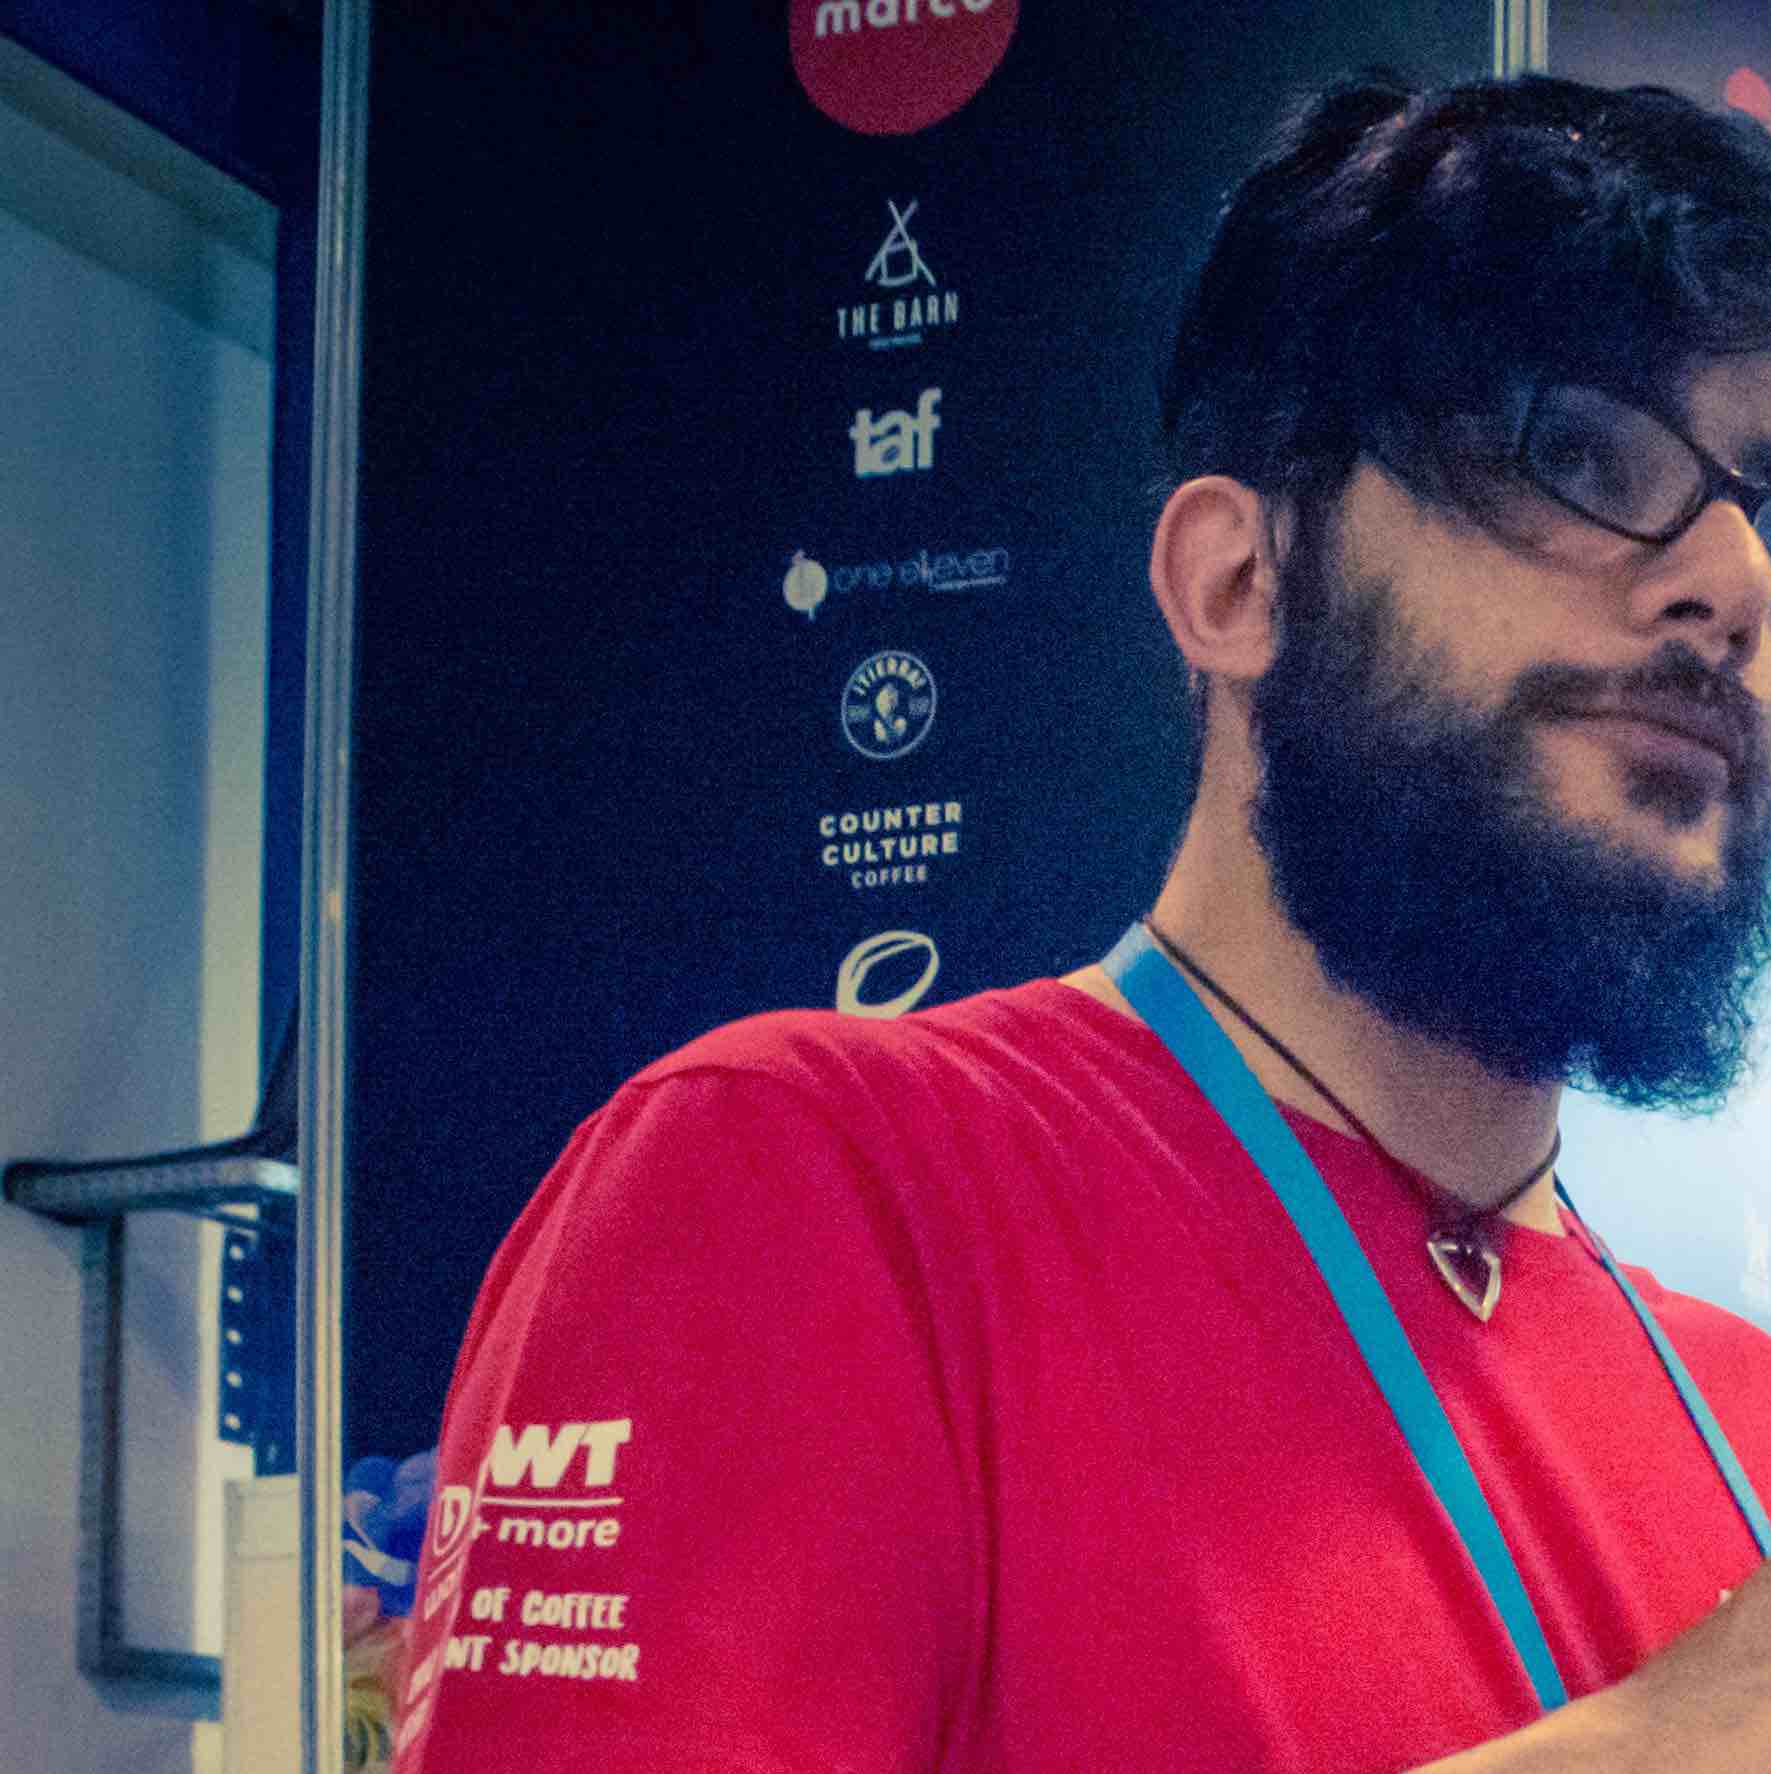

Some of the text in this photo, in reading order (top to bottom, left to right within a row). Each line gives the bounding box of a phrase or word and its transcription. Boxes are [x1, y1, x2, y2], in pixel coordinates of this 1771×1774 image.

[837, 292, 959, 339] THE BARN
[848, 387, 942, 478] taf
[819, 802, 963, 837] COUNTER
[821, 831, 960, 866] CULTURE
[851, 864, 928, 889] COFFEE
[480, 1418, 632, 1488] WT
[471, 1587, 630, 1629] OF COFFEE
[500, 1638, 641, 1682] SPONSOR
